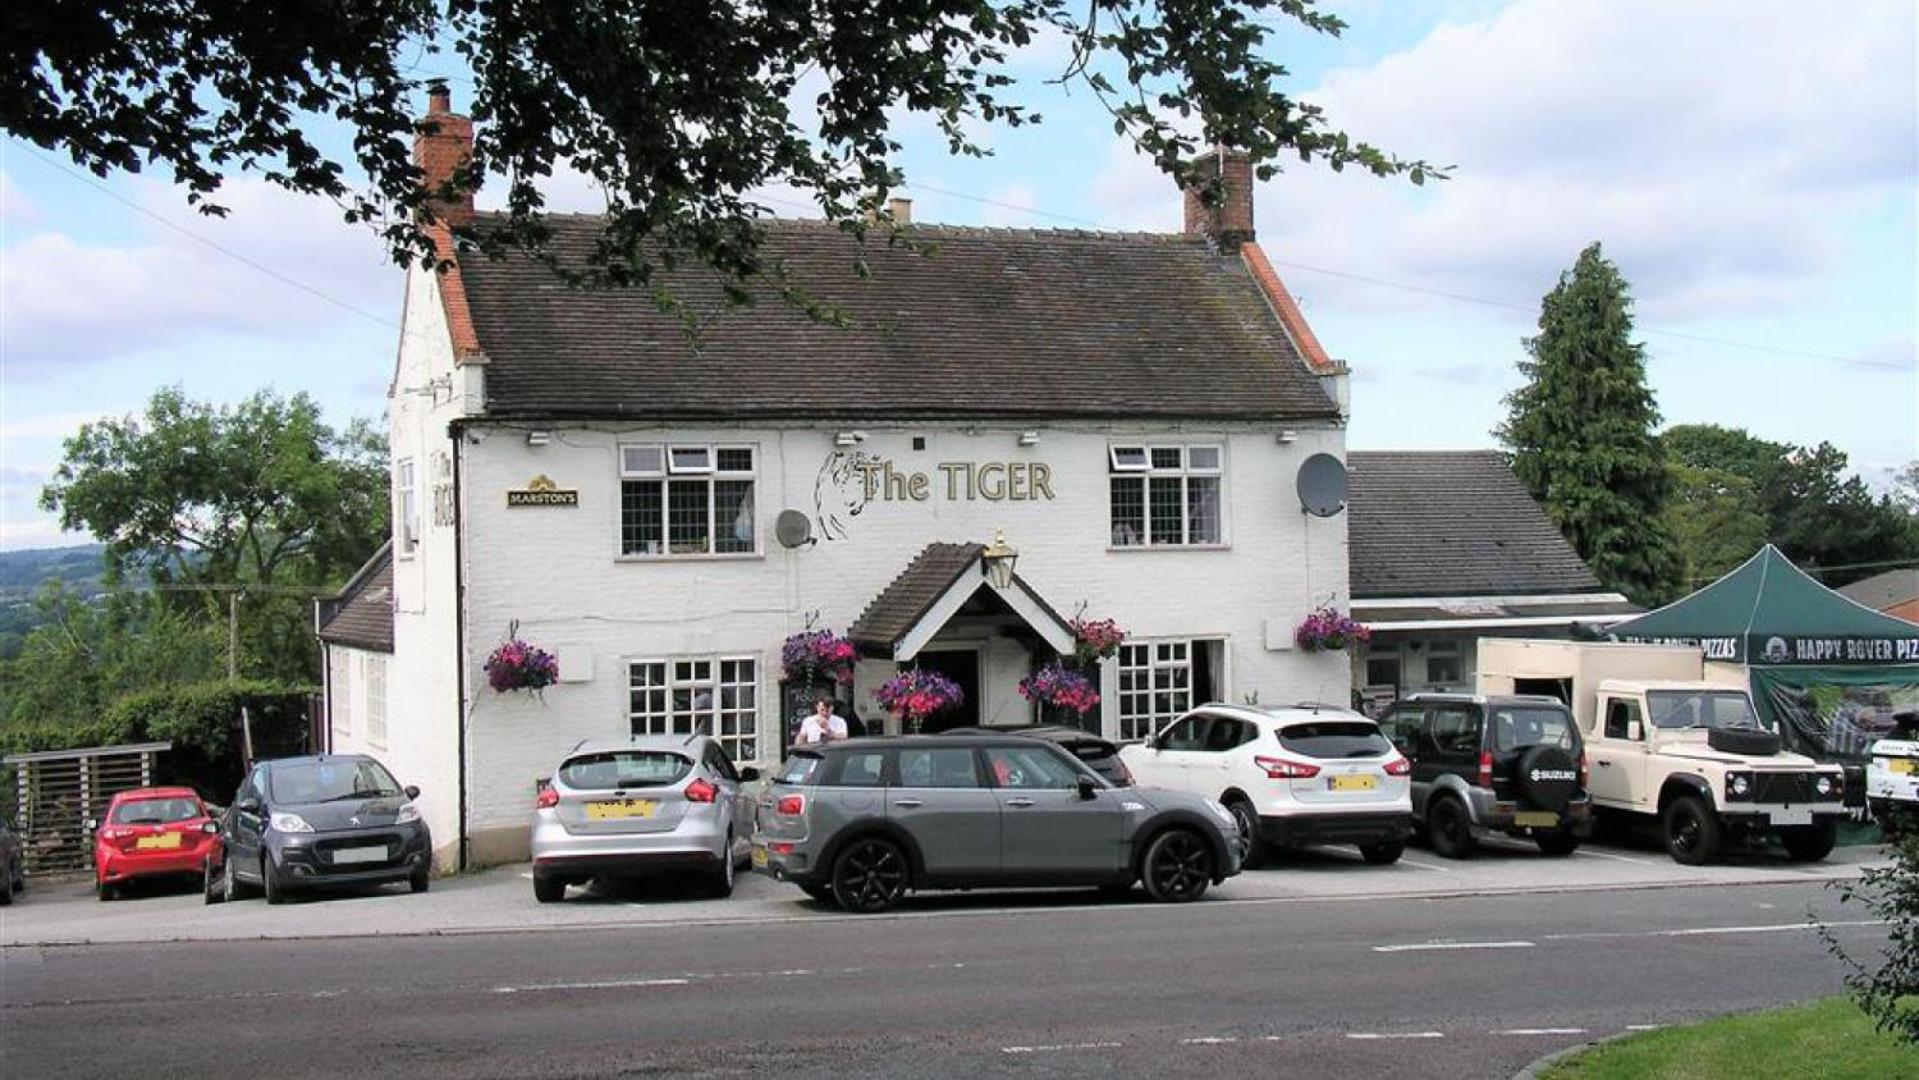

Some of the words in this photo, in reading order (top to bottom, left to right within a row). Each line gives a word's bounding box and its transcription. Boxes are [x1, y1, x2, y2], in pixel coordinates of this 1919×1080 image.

[861, 461, 930, 501] The
[938, 462, 1056, 501] TIGER
[509, 492, 577, 505] MARSTON'S
[1701, 637, 1737, 658] PIZZAS
[1795, 639, 1842, 660] HAPPY
[1846, 639, 1893, 660] ROVER
[1540, 769, 1576, 780] SUZUKI
